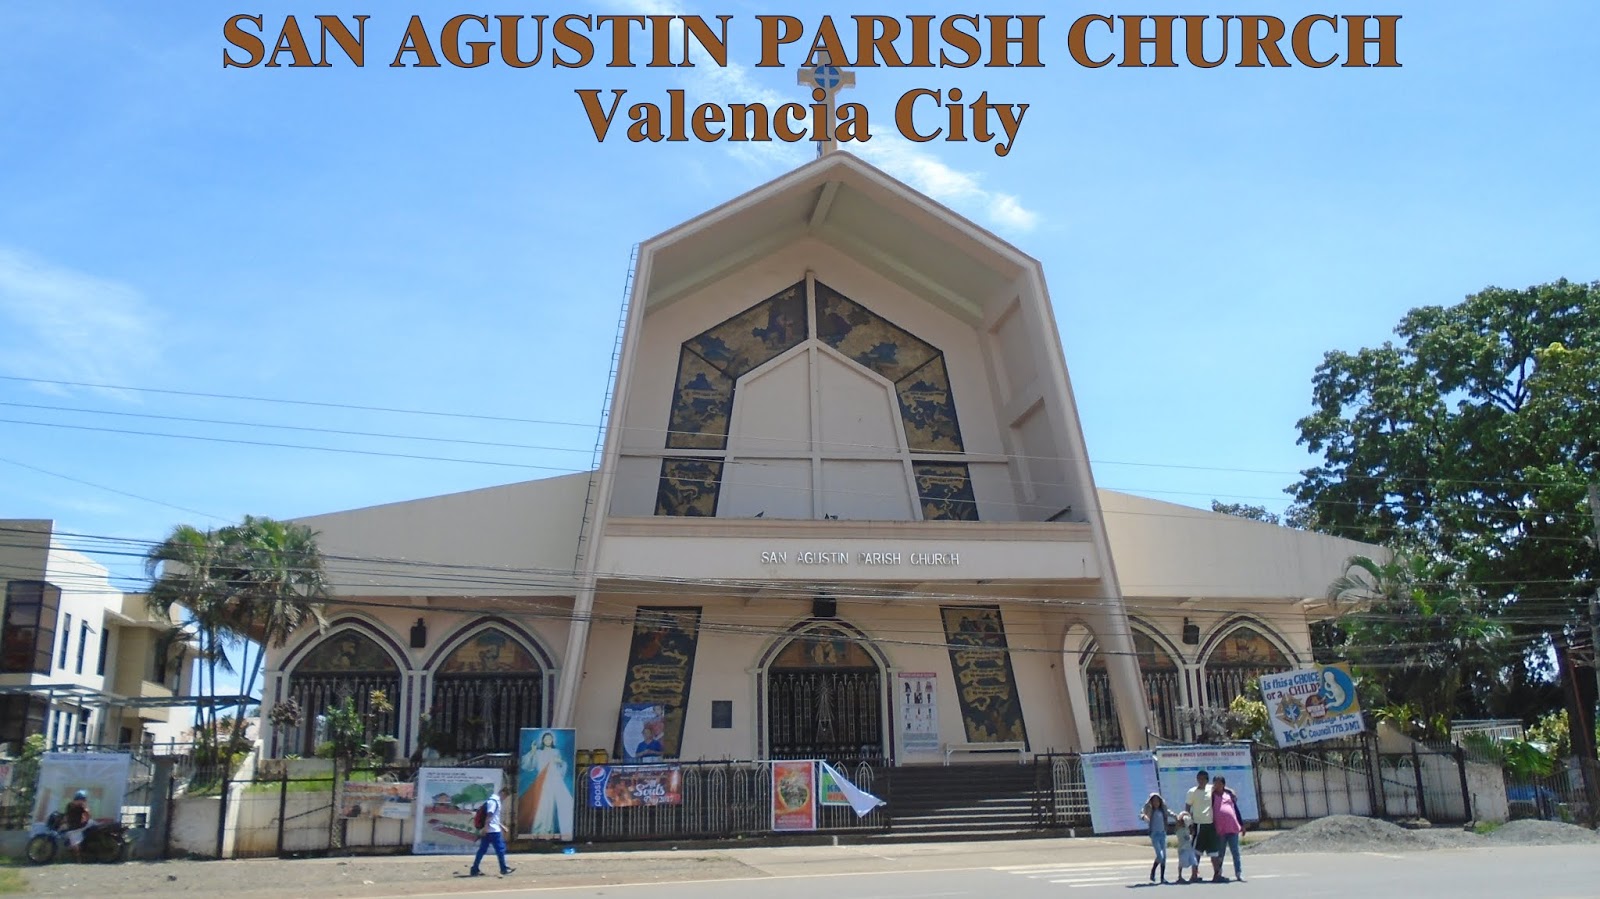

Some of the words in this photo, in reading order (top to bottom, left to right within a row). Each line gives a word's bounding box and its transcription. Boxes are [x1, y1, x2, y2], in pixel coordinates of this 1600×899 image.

[760, 552, 787, 565] SAN
[797, 552, 849, 565] AGUSTIN
[856, 552, 901, 566] PARISH
[910, 553, 960, 566] CHURCH
[1263, 680, 1271, 691] Is
[1272, 677, 1288, 689] this
[1289, 678, 1294, 686] a
[1294, 672, 1320, 685] CHOICE
[1266, 692, 1276, 701] or
[1277, 690, 1283, 699] a
[594, 780, 602, 807] pepsi
[633, 783, 666, 797] Souls
